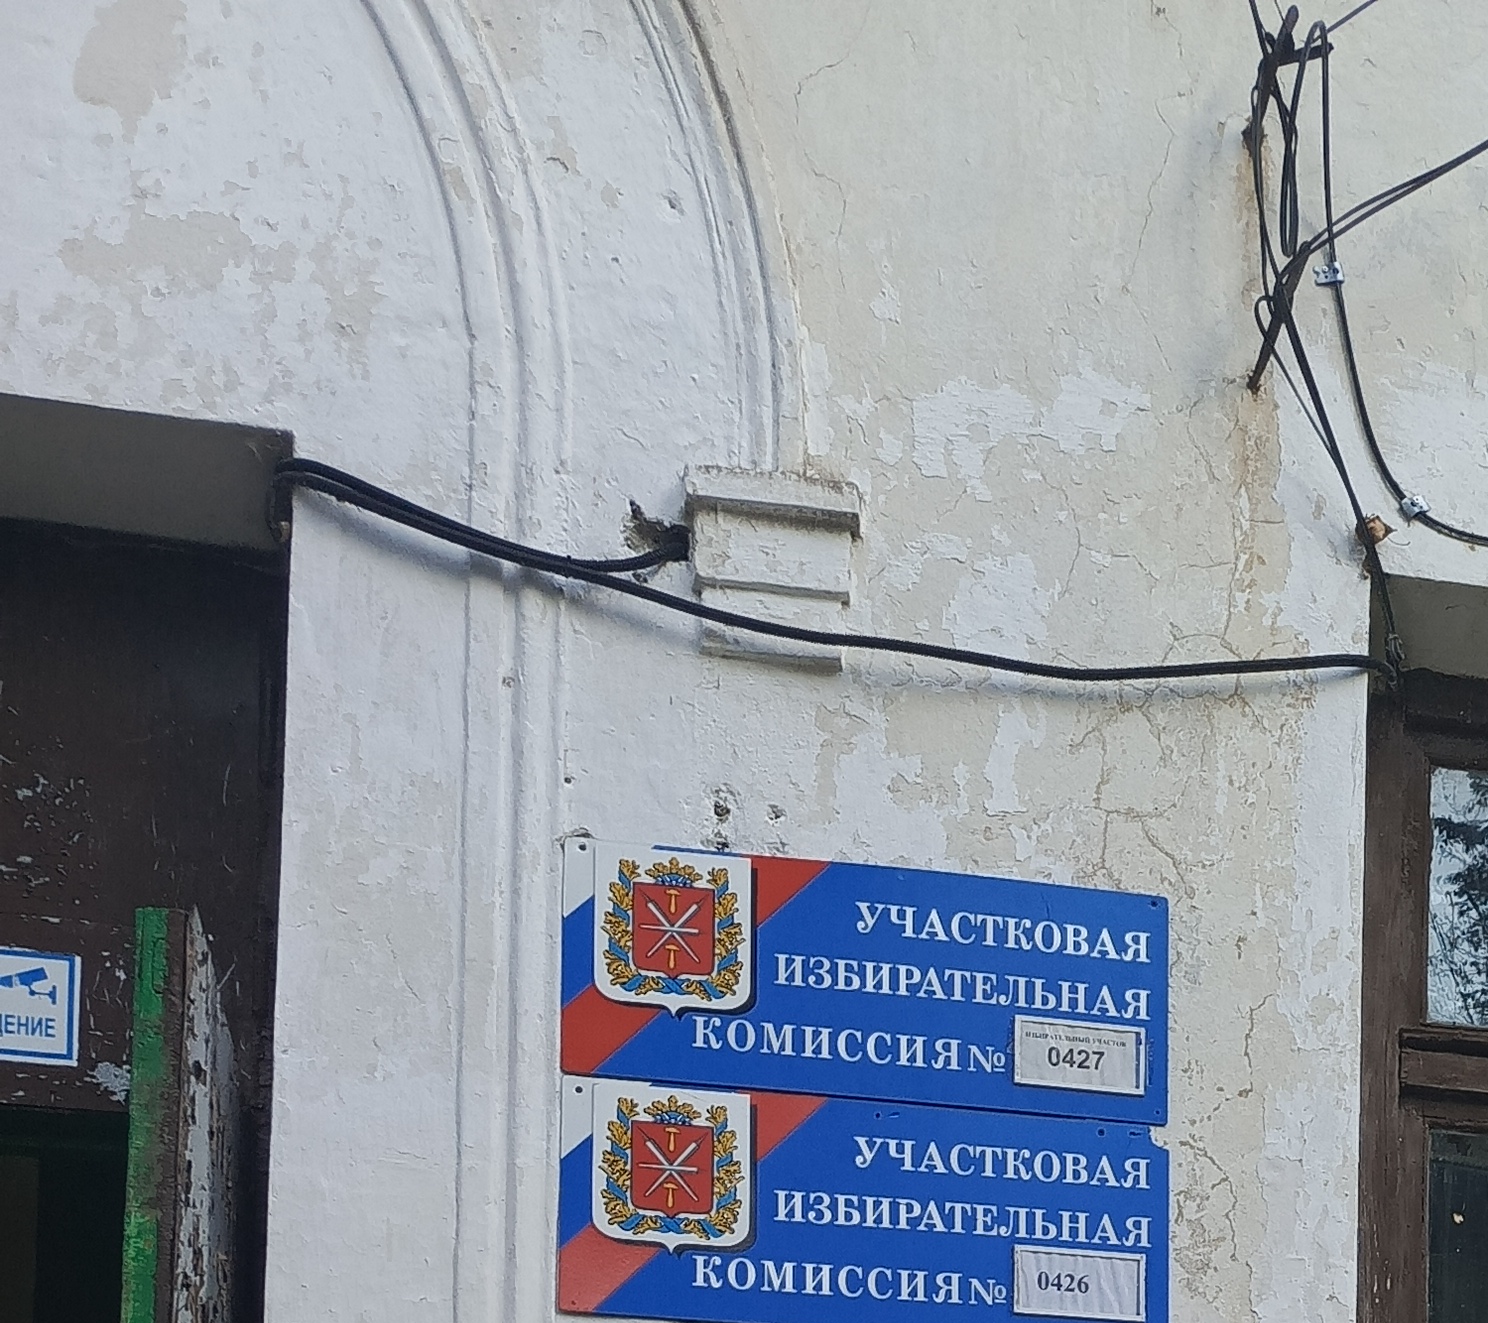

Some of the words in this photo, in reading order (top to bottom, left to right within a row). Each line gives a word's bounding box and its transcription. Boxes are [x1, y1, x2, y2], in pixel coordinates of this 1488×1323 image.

[854, 901, 1152, 963] УЧАСТКОВАЯ
[773, 953, 1152, 1021] ИЗБИРАТЕЛЬНАЯ
[692, 1016, 961, 1070] КОМИССИЯ
[968, 1046, 1006, 1073] №
[1047, 1046, 1105, 1070] 0427
[854, 1137, 1152, 1190] УЧАСТКОВАЯ
[773, 1190, 1152, 1248] ИЗБИРАТЕЛЬНАЯ
[692, 1255, 961, 1305] КОМИССИЯ
[968, 1281, 1007, 1304] №
[1037, 1271, 1090, 1294] 0426
